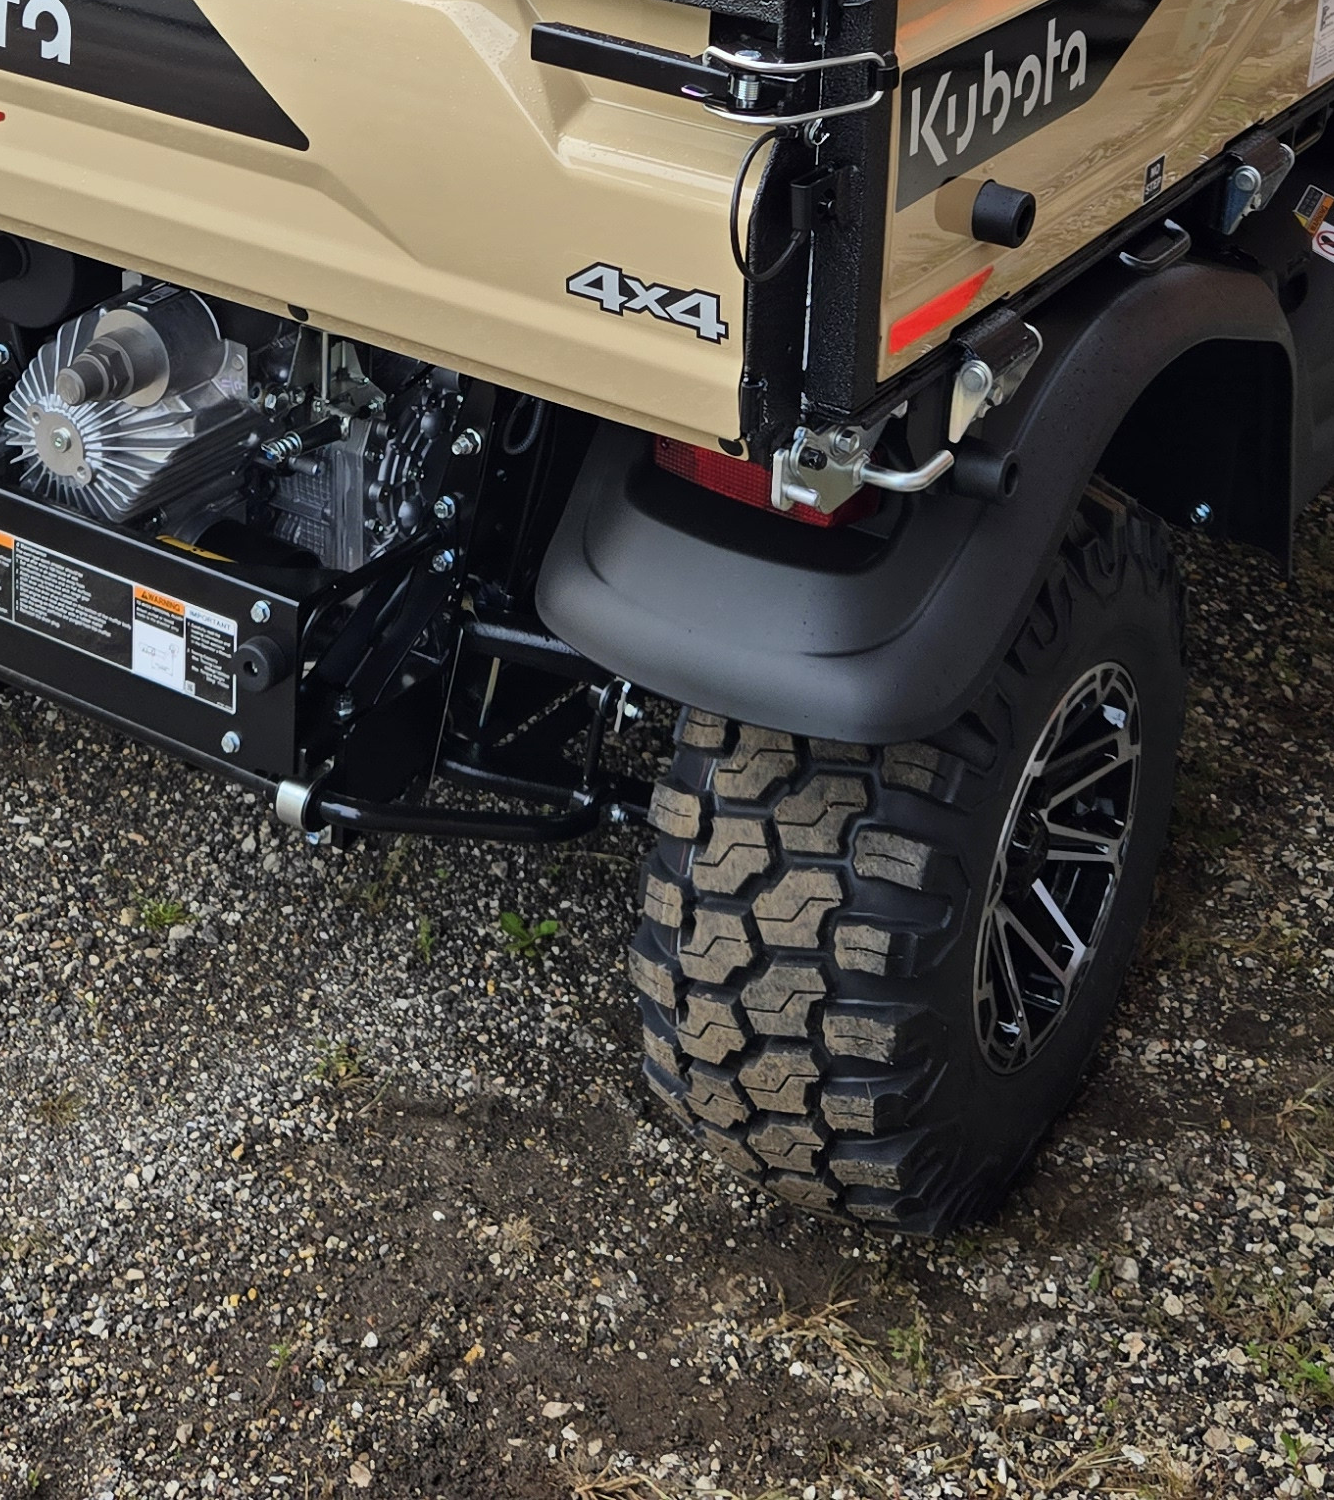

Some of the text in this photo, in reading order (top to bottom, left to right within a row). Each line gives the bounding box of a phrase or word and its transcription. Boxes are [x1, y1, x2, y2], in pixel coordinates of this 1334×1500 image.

[909, 17, 1087, 167] Kubota
[1150, 163, 1161, 178] NO
[1145, 176, 1162, 195] STEP
[567, 263, 728, 343] 4x4
[147, 593, 181, 612] WARNING
[189, 611, 231, 630] IMPORTANT
